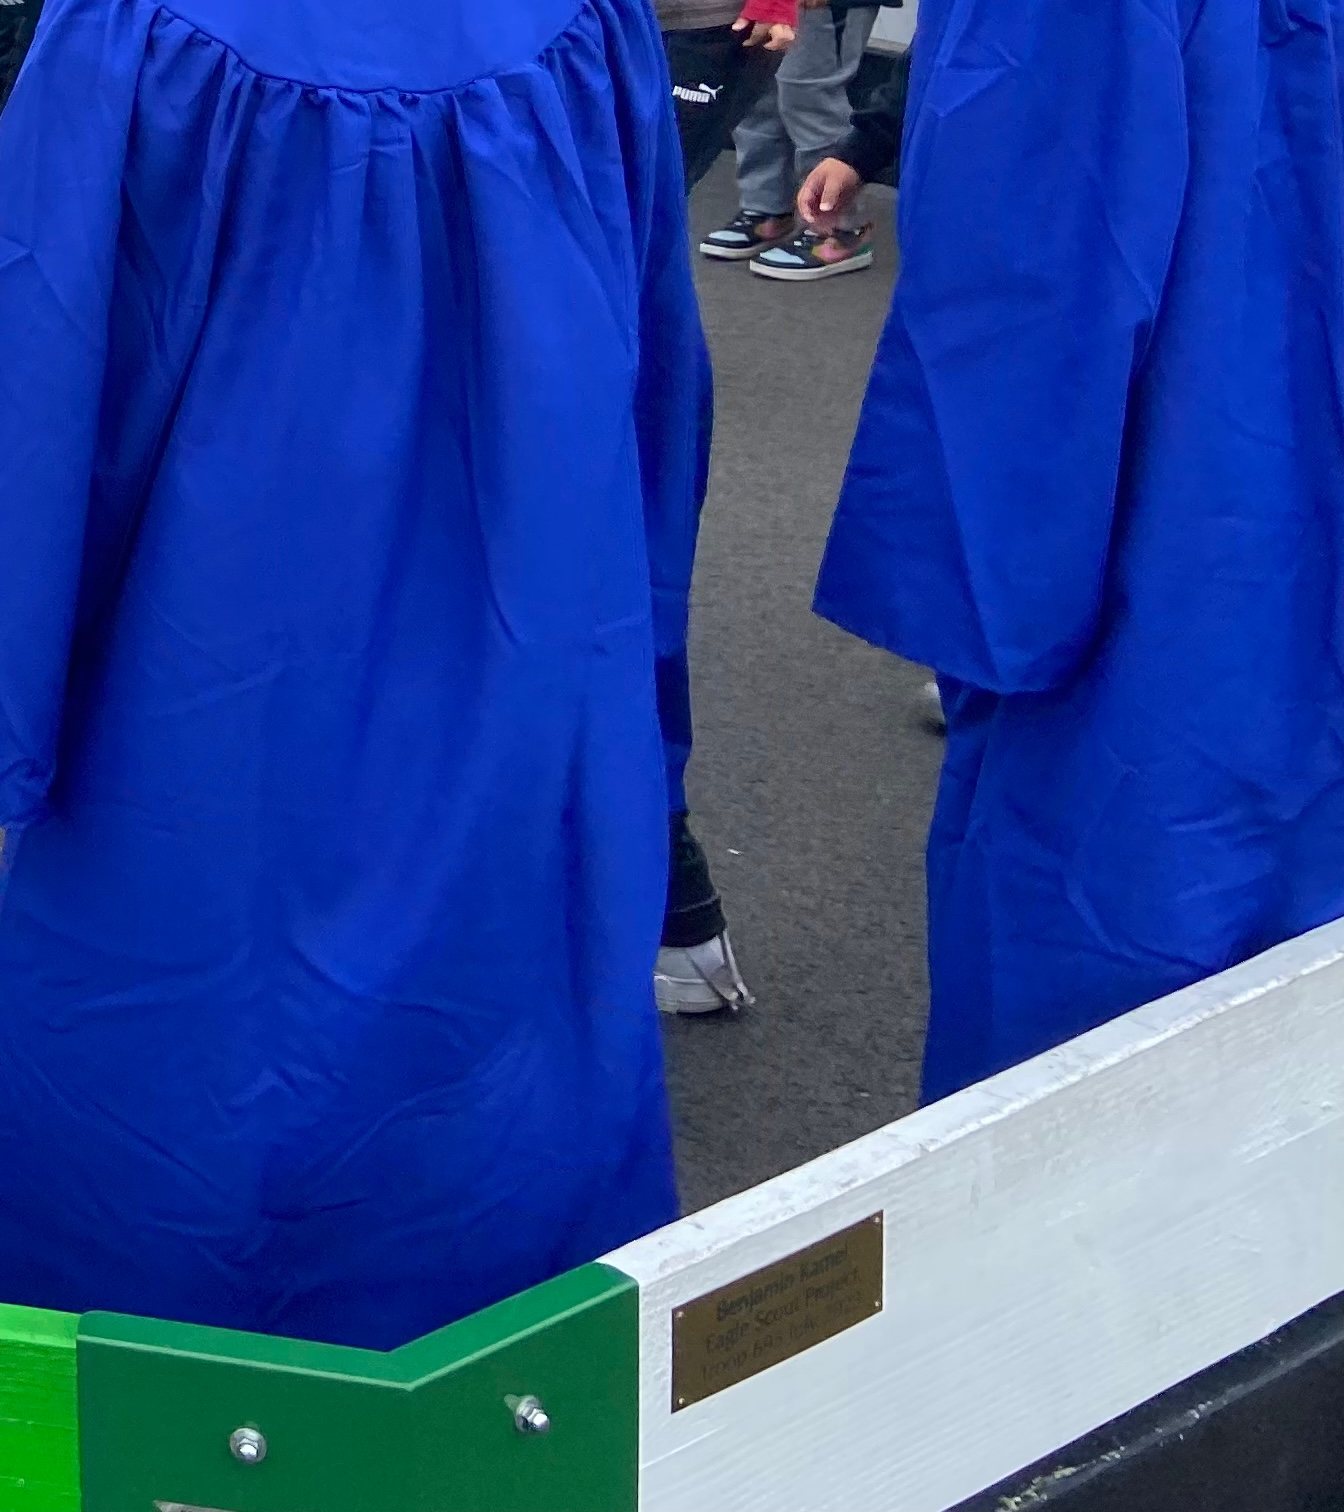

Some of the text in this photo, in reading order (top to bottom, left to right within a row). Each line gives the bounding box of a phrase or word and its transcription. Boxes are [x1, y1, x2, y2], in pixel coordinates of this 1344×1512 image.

[706, 1321, 750, 1354] Eagle
[754, 1299, 800, 1332] Scout
[805, 1266, 861, 1308] Project
[716, 1271, 795, 1322] Benjamin
